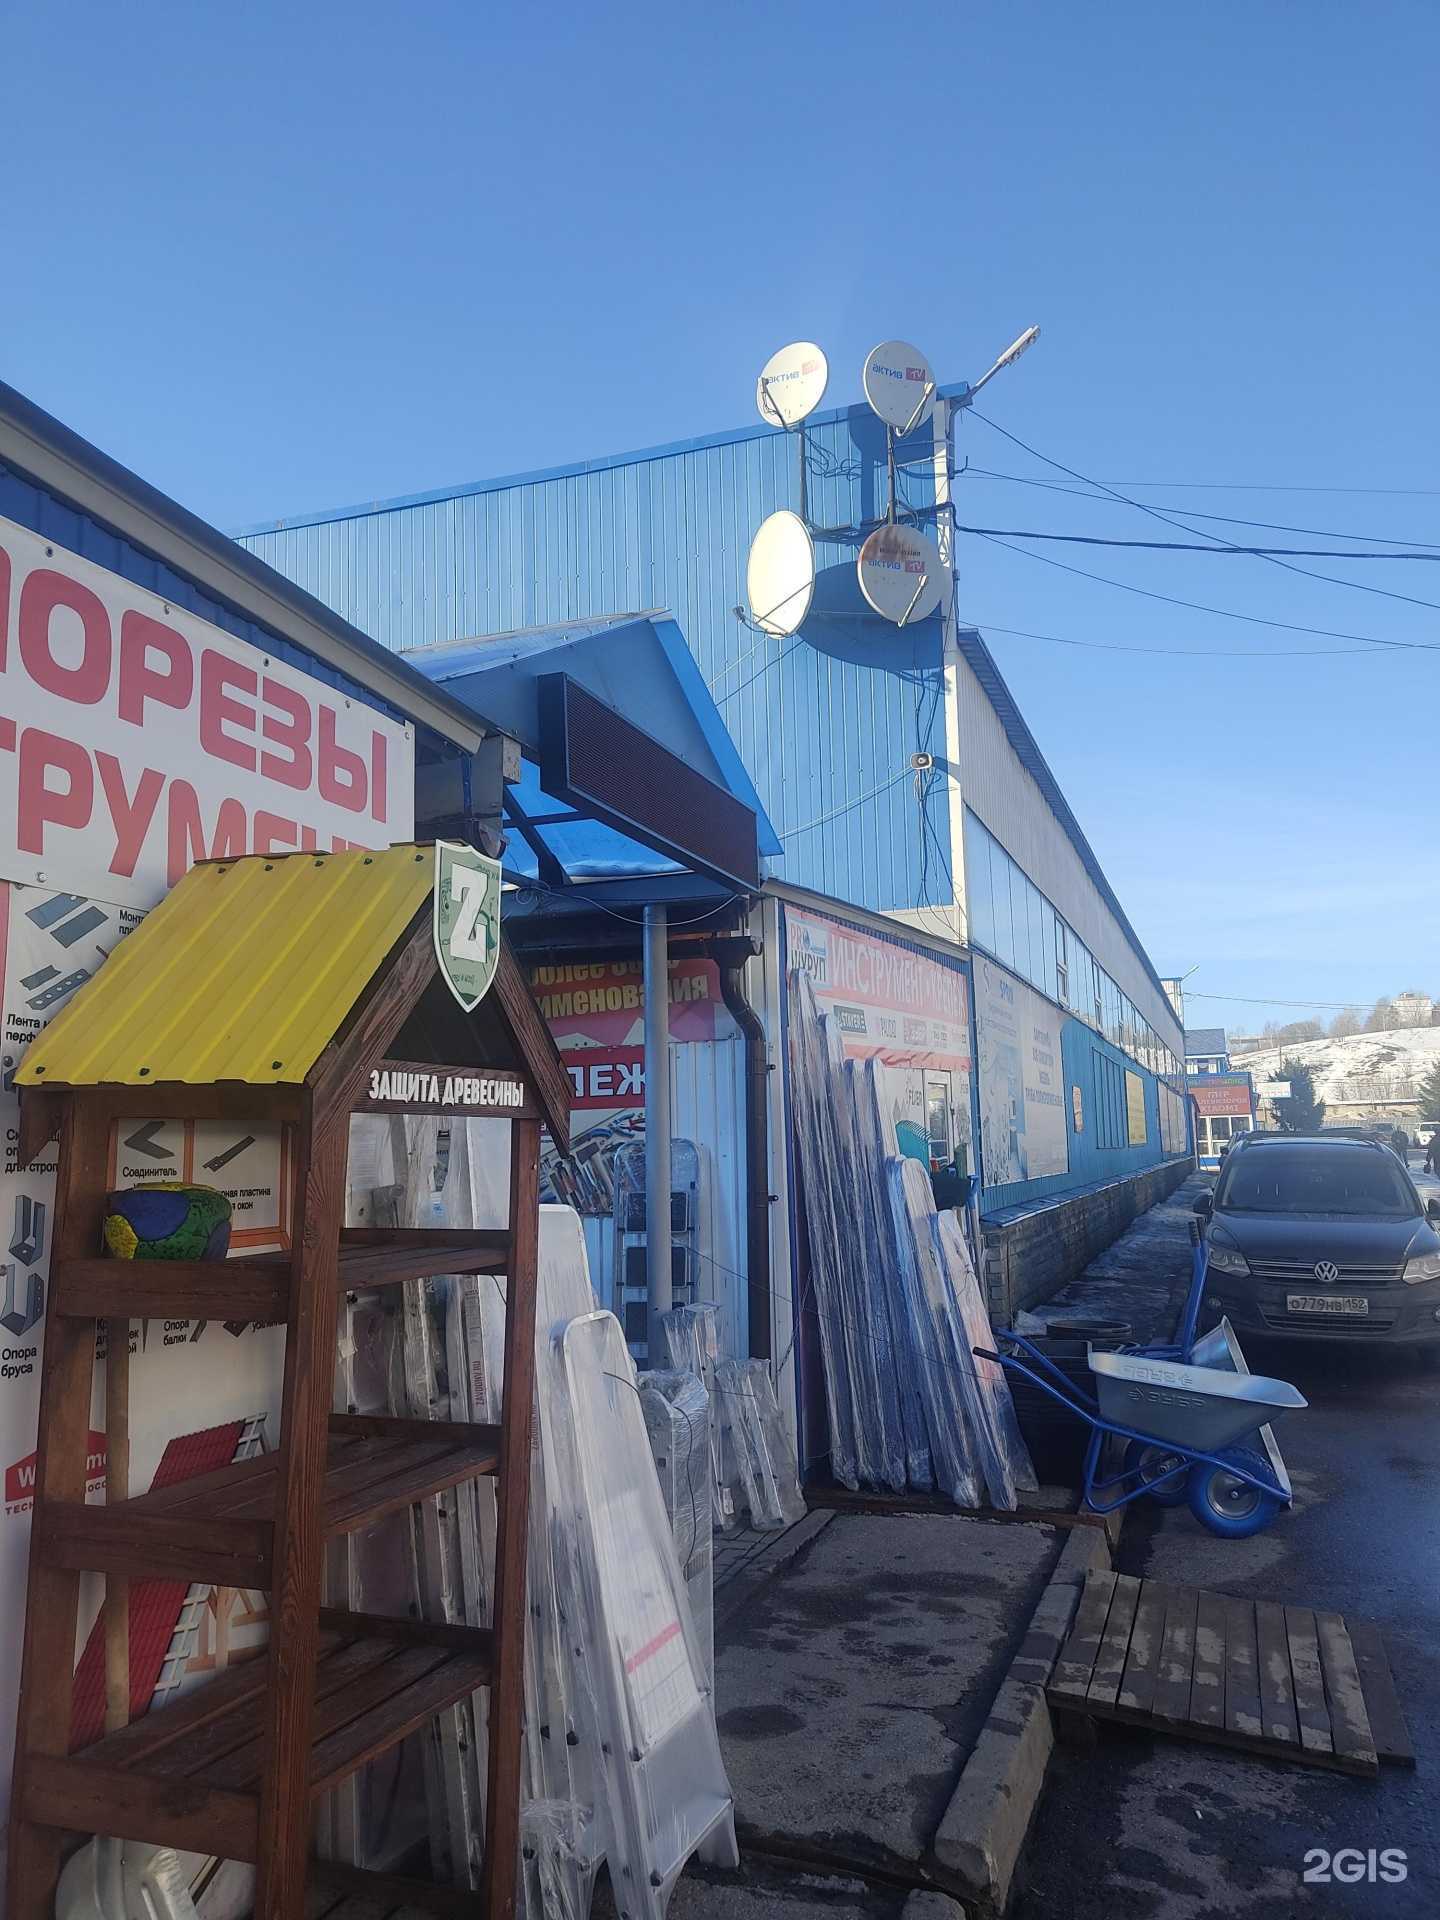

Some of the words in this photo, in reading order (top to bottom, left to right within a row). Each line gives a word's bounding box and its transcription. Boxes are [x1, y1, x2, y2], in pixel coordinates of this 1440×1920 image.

[530, 962, 605, 986] олее
[831, 933, 923, 1006] ИНСТРУМЕНТ
[7, 1013, 41, 1029] Лента
[369, 1069, 440, 1103] ЗАЩИТА
[441, 1076, 524, 1107] ДРЕВЕСИНЫ
[122, 1166, 177, 1178] Соединитель
[240, 1187, 271, 1197] пластина
[237, 1201, 253, 1210] окон
[163, 1319, 190, 1332] Опора
[163, 1333, 187, 1346] балки
[2, 1347, 37, 1360] Опора
[1, 1363, 33, 1379] бруса
